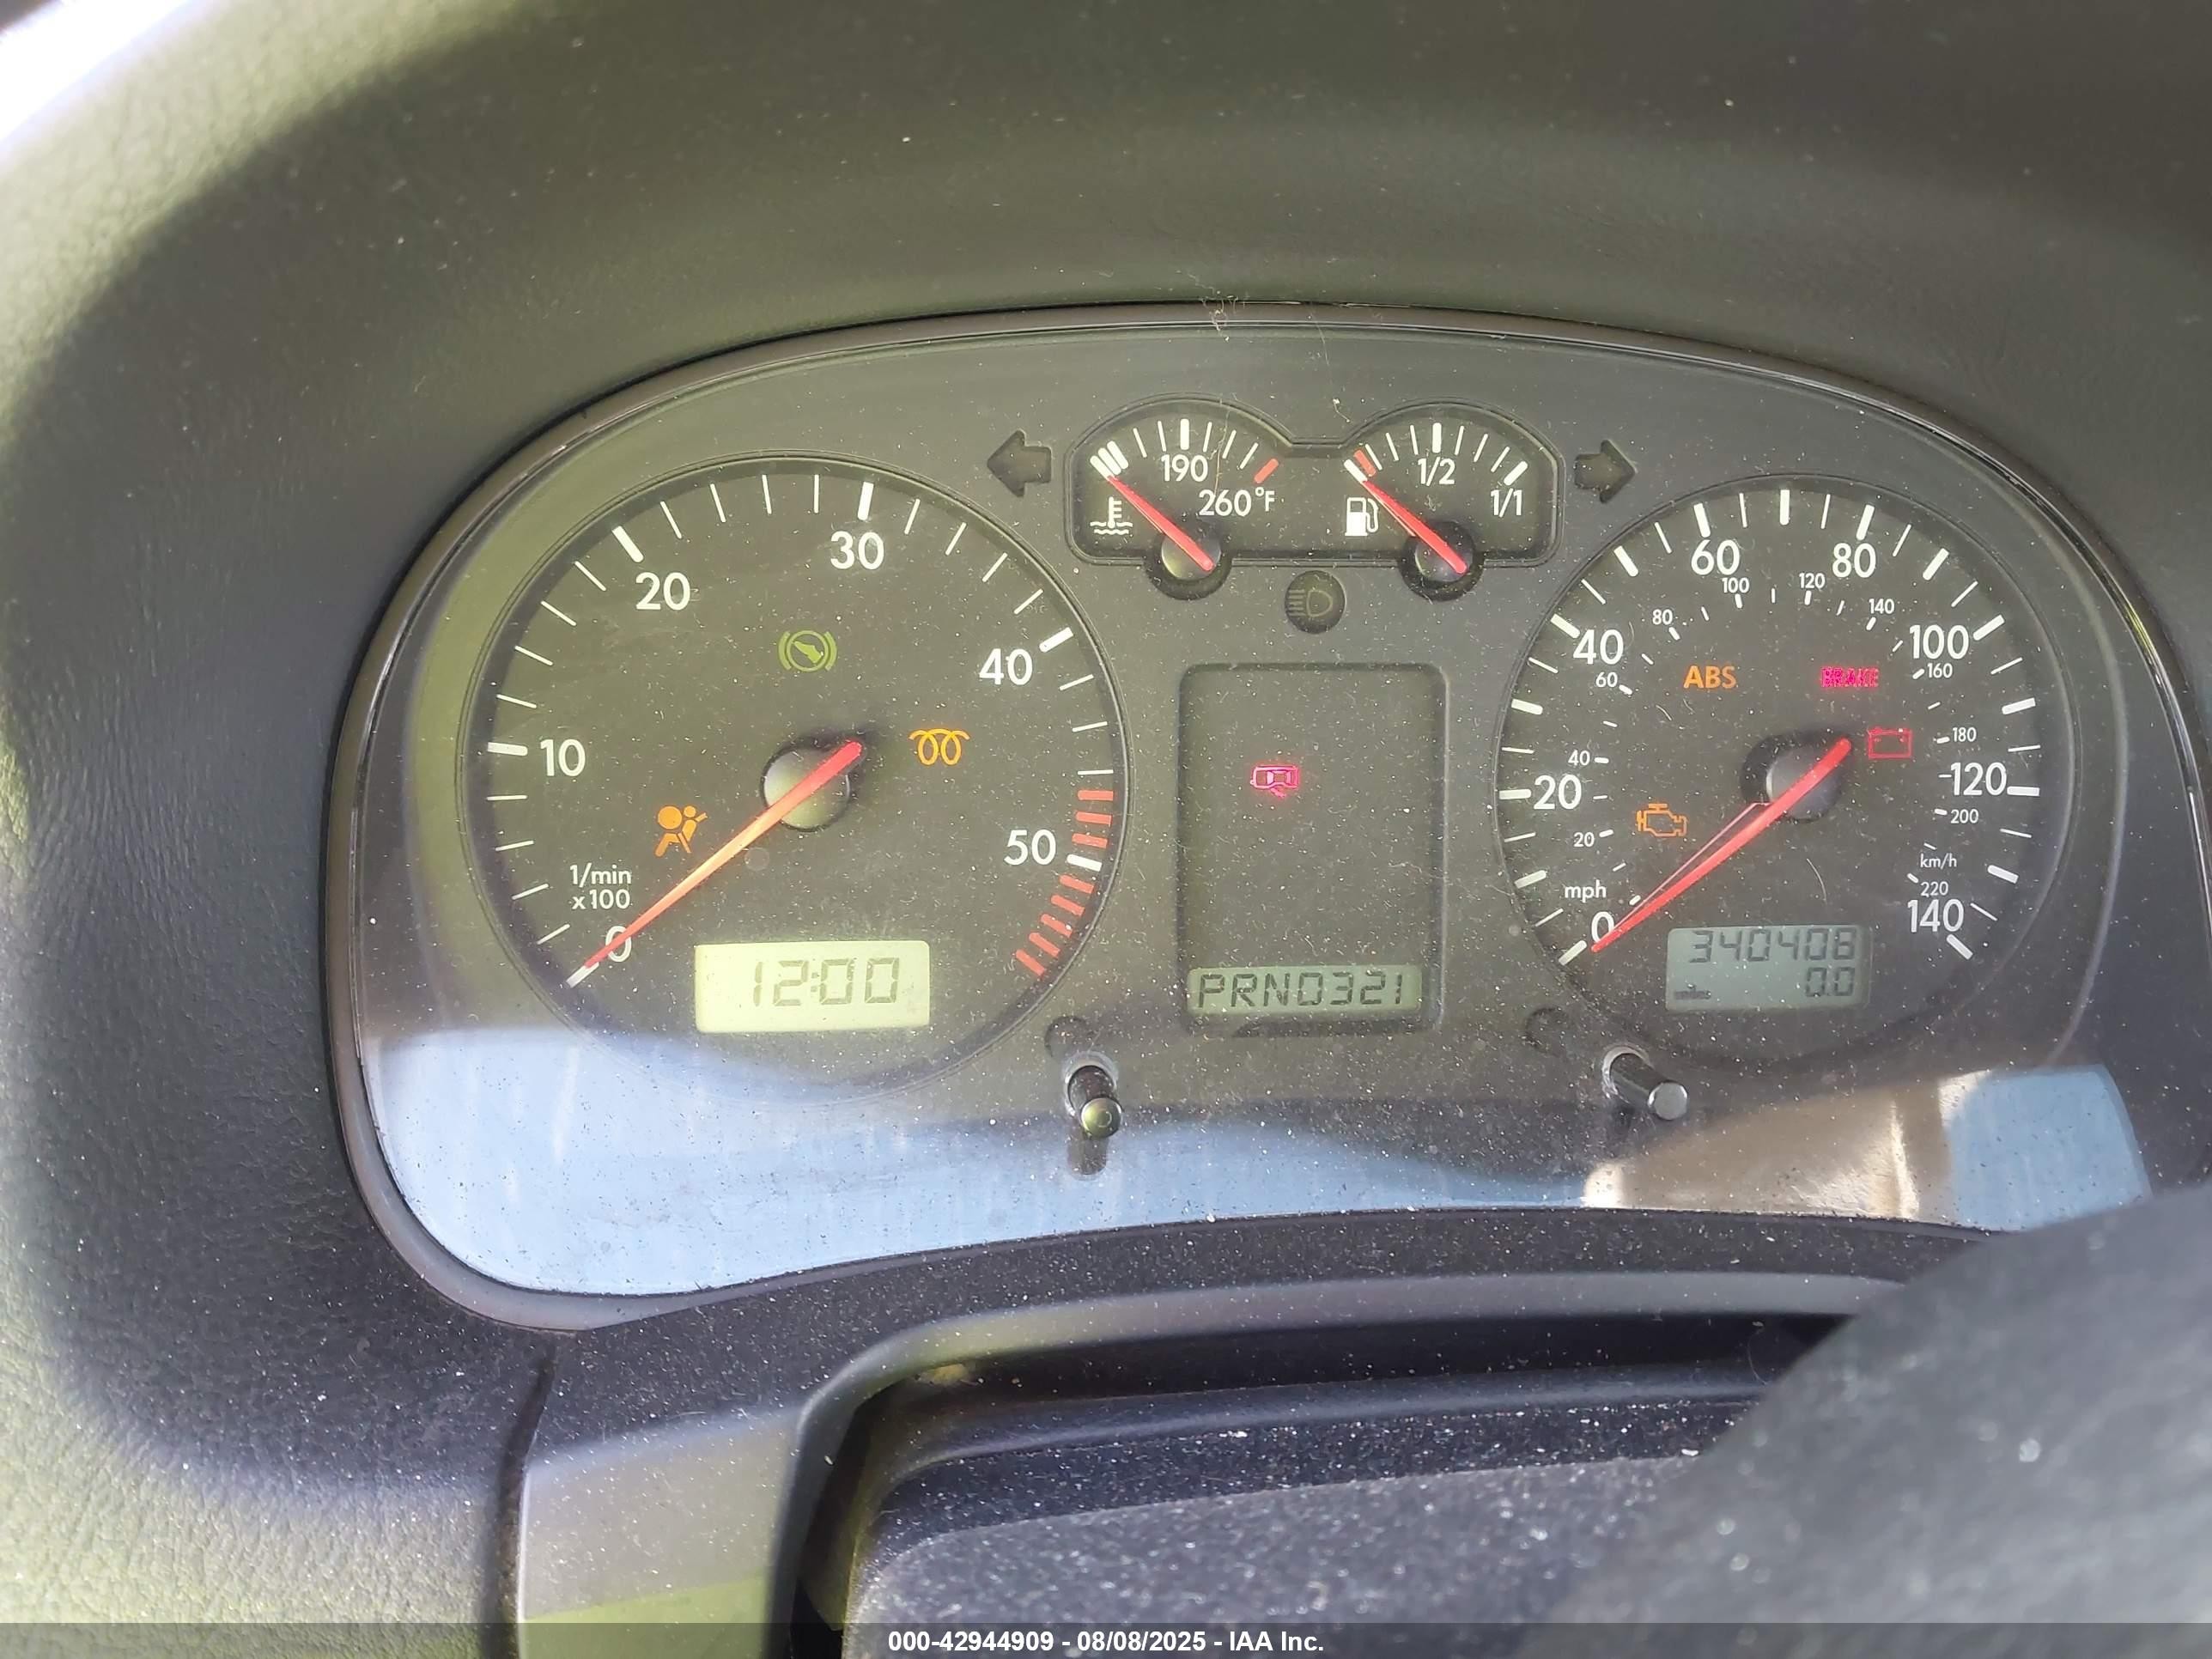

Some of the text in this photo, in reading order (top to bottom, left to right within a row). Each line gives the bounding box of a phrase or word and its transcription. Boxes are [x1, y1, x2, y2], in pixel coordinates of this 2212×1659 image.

[1161, 454, 1208, 482] 190
[1417, 455, 1455, 485] 1/2
[1490, 489, 1522, 516] 1/1
[830, 531, 884, 570] 30
[1691, 539, 1741, 575] 60
[1832, 543, 1877, 578] 80
[635, 572, 691, 611] 20
[1722, 577, 1750, 593] 100
[1799, 573, 1826, 590] 120
[1651, 610, 1673, 626] 80
[1869, 599, 1895, 615] 140
[1573, 629, 1624, 665] 40
[1909, 625, 1969, 659] 100
[979, 648, 1032, 687] 40
[1595, 672, 1618, 688] 60
[1683, 665, 1737, 689] ABS
[1821, 667, 1879, 688] BRAKE
[1927, 663, 1954, 679] 160
[1953, 727, 1977, 743] 180
[540, 738, 585, 777] 10
[1568, 751, 1590, 767] 40
[1533, 775, 1582, 810] 20
[1951, 763, 2007, 796] 120
[1950, 809, 1978, 824] 200
[1005, 830, 1056, 866] 50
[1573, 832, 1595, 848] 20
[569, 862, 632, 887] 1/min
[1920, 854, 1957, 870] km/h
[1565, 878, 1607, 903] mph
[1920, 881, 1948, 897] 220
[1591, 911, 1614, 943] 0
[1907, 898, 1964, 933] 140
[605, 926, 632, 962] 0
[1689, 927, 1856, 963] 340408
[750, 957, 900, 1008] 12:00
